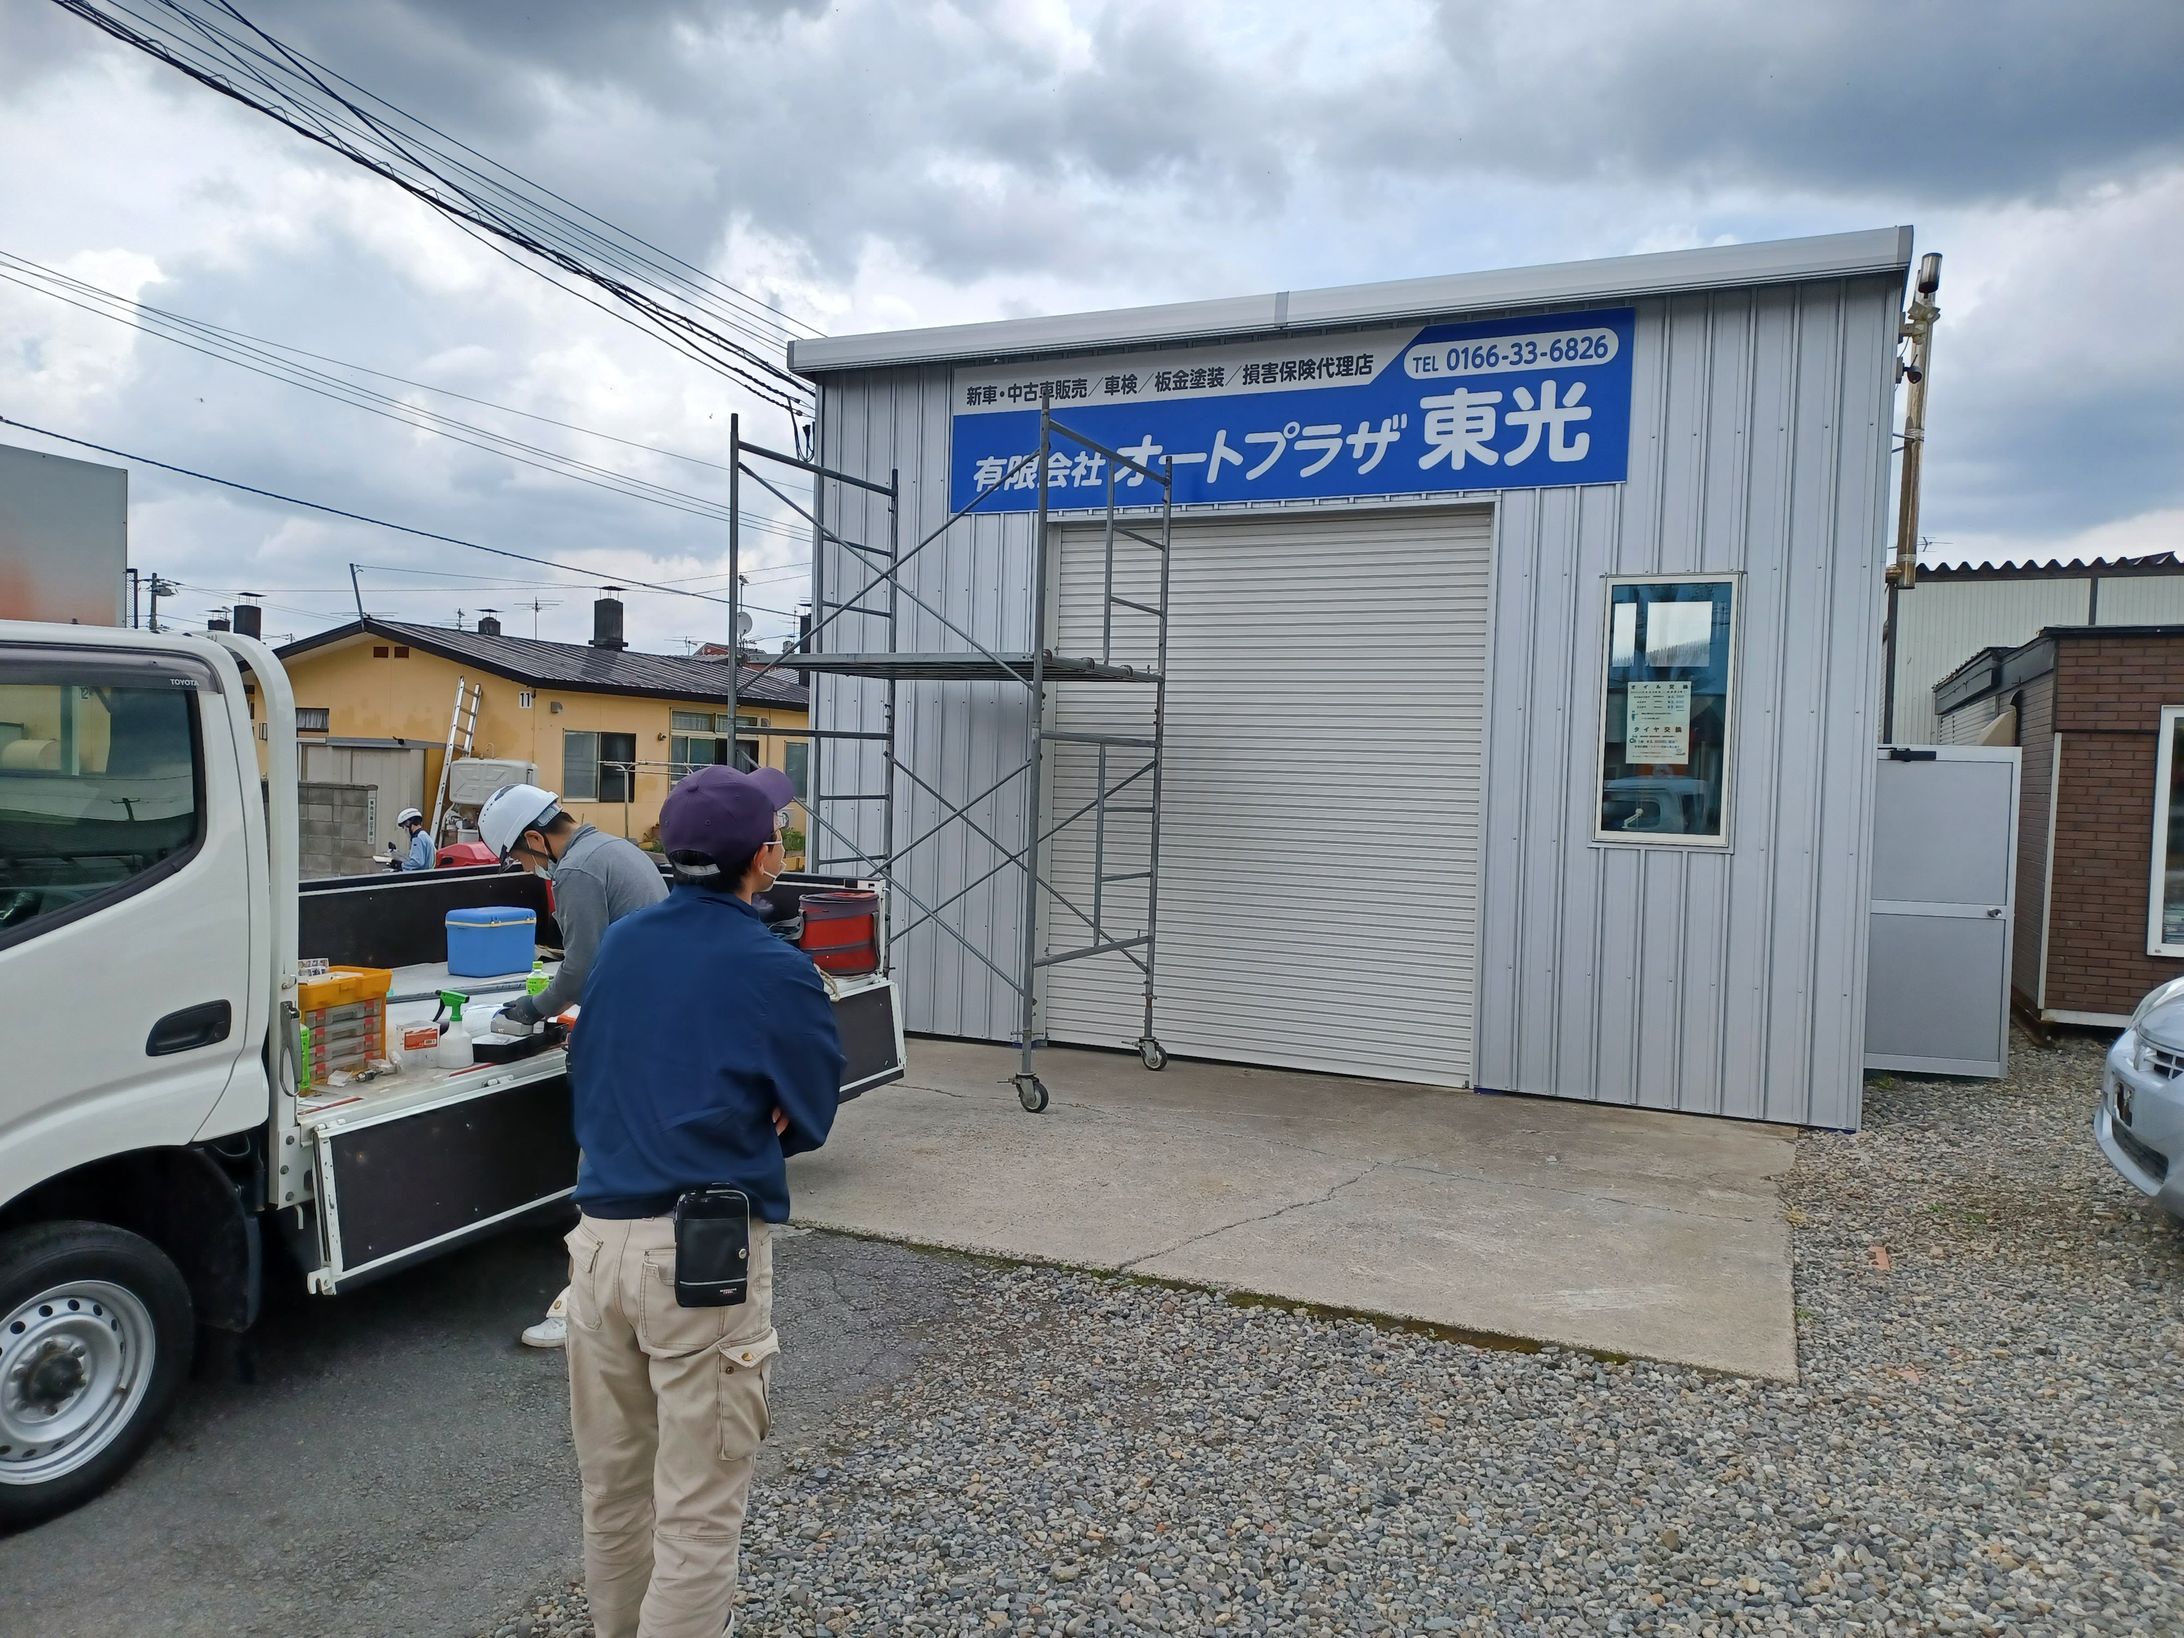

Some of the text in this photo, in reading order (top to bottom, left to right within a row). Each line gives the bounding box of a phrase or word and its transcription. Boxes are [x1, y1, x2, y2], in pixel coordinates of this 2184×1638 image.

[1412, 334, 1609, 374] TEL 0166-33-6826
[972, 450, 1107, 493] 有限会社
[1417, 378, 1593, 471] 東光
[169, 678, 200, 688] TOYOTA
[519, 692, 531, 708] 11
